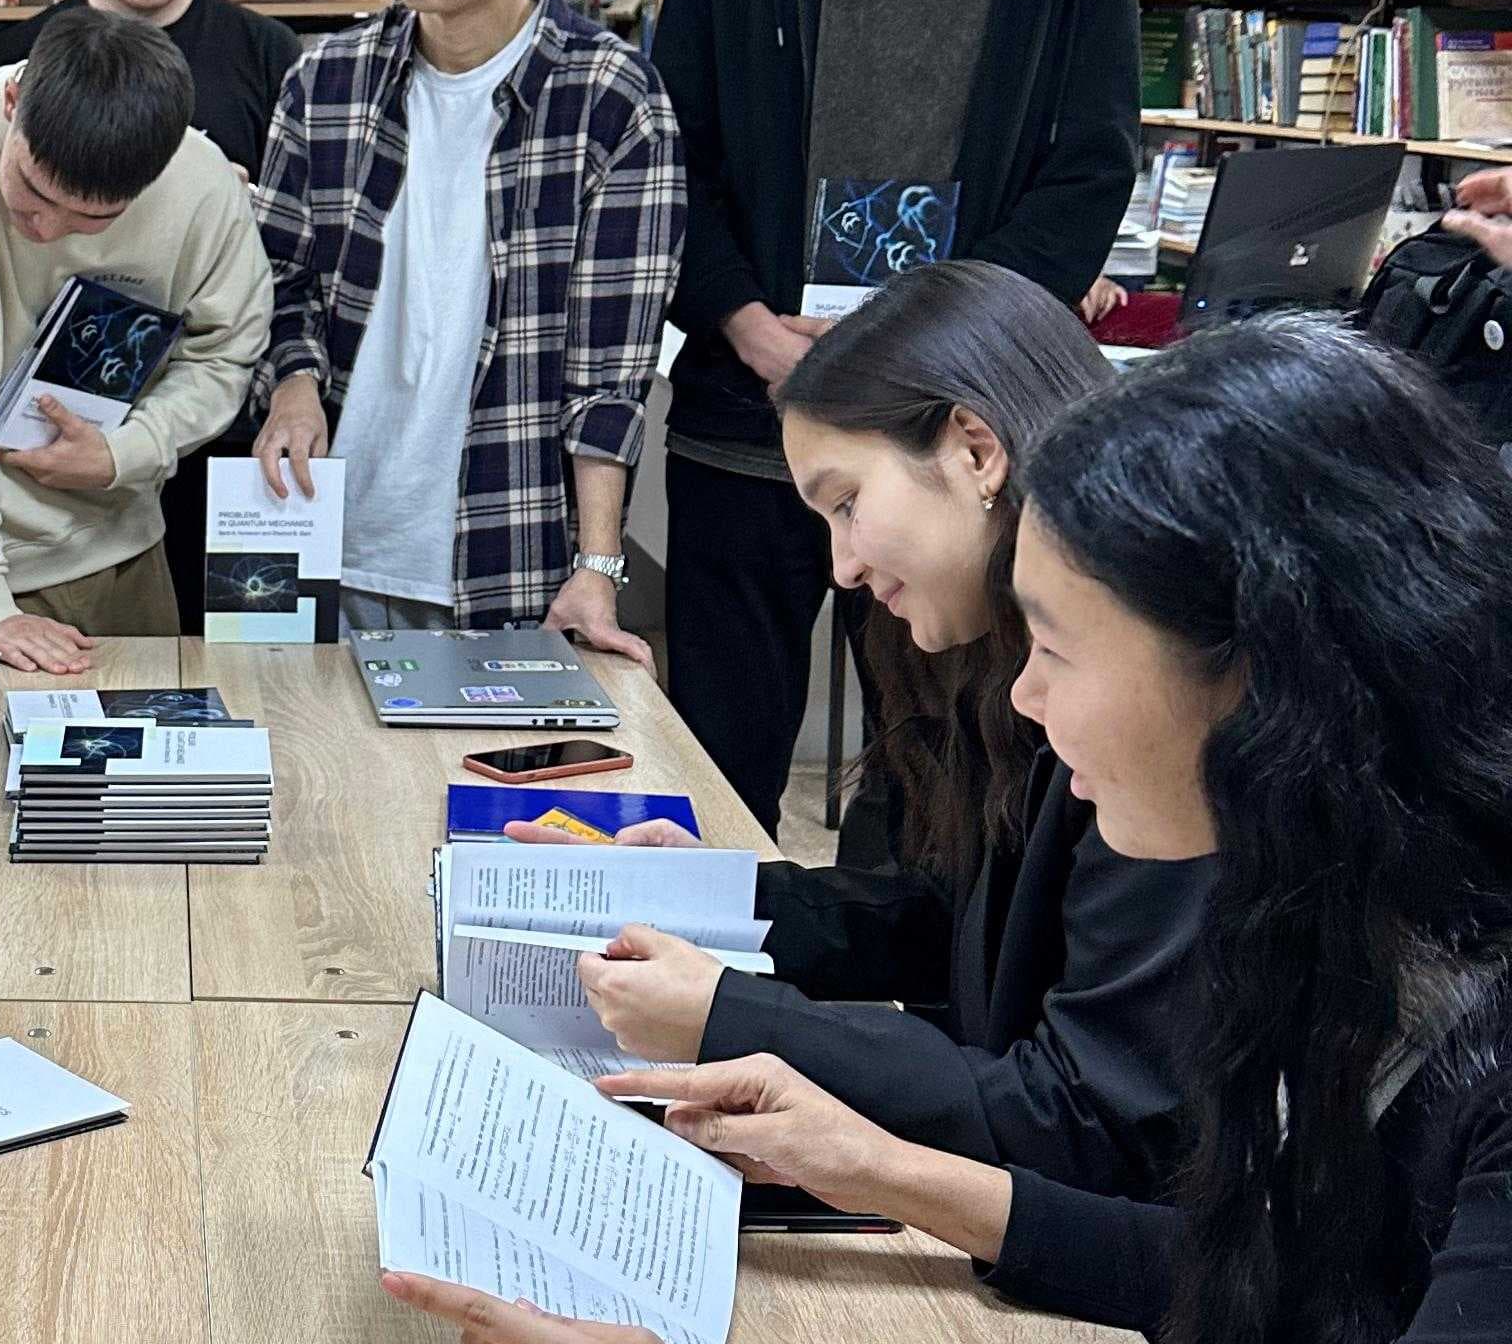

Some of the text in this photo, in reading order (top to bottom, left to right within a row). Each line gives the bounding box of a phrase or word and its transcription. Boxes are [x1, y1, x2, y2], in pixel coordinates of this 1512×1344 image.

[218, 511, 261, 519] PROBLEMS
[218, 520, 314, 528] IN QUANTUM MECHANICS
